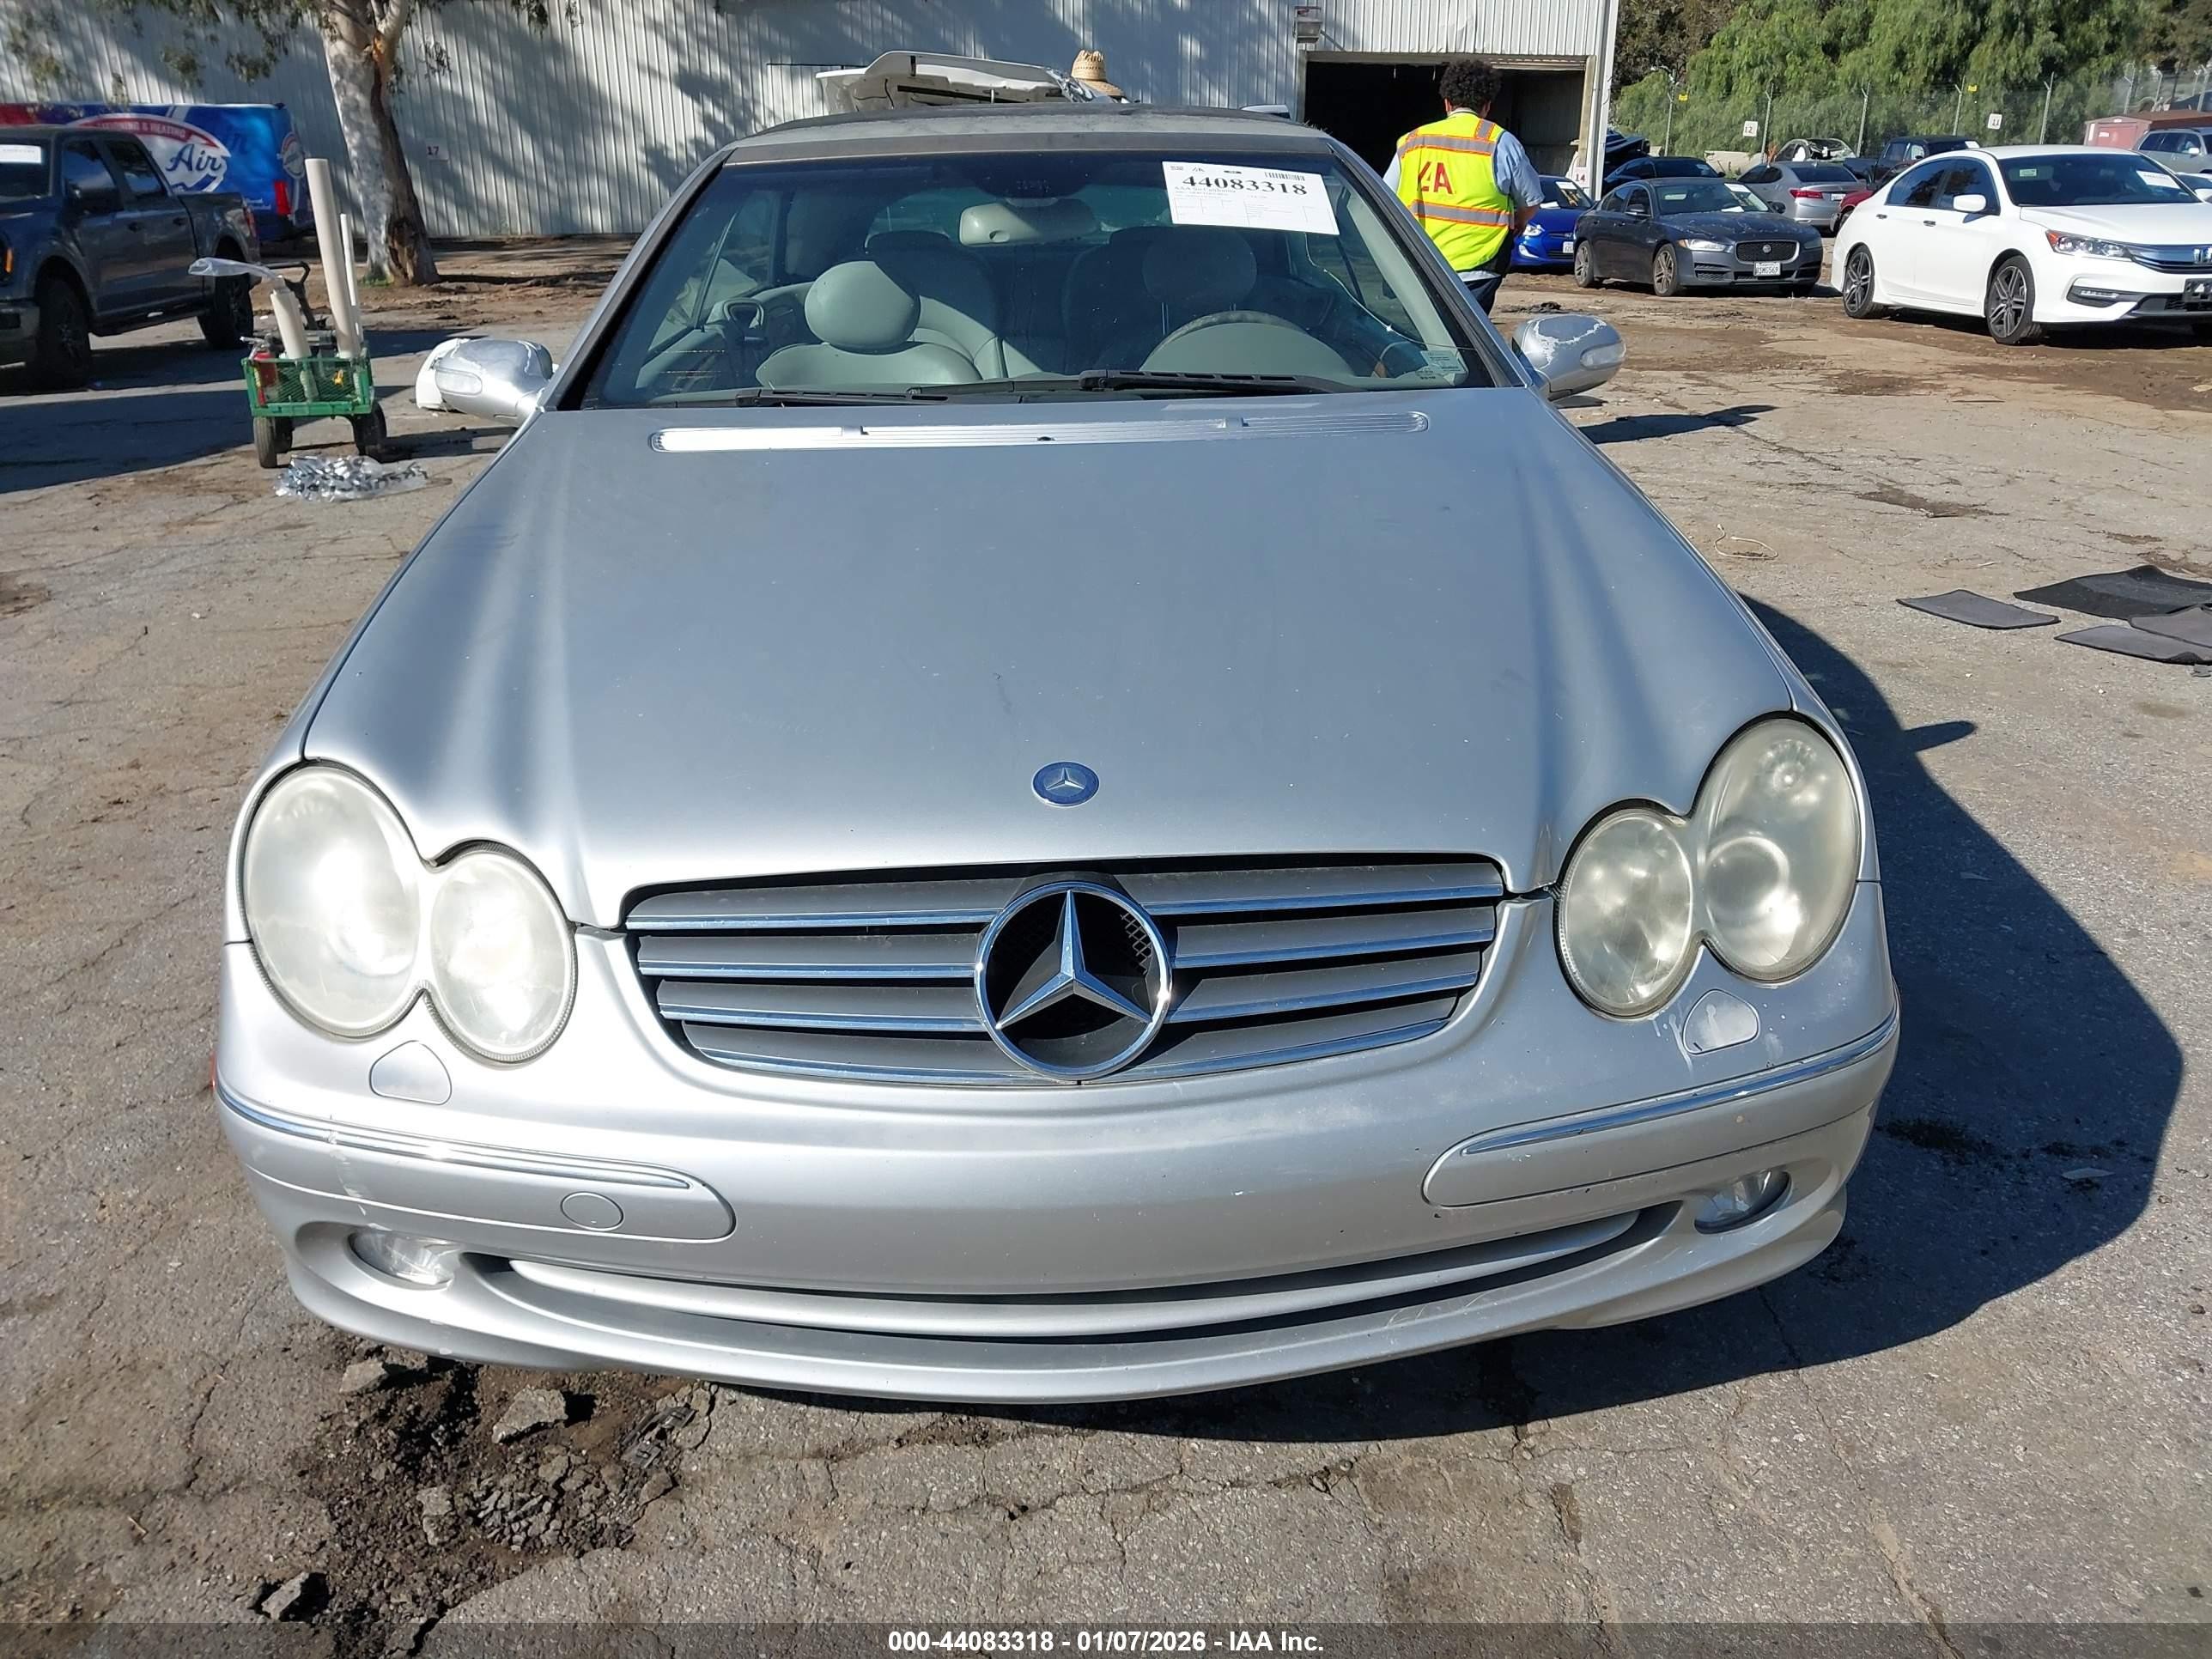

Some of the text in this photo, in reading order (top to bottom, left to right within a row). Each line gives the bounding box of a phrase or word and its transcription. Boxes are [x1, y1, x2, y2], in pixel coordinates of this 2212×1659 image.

[165, 143, 222, 172] Air
[427, 145, 440, 155] 17
[1182, 175, 1308, 195] 44083318
[1575, 173, 1585, 182] 14
